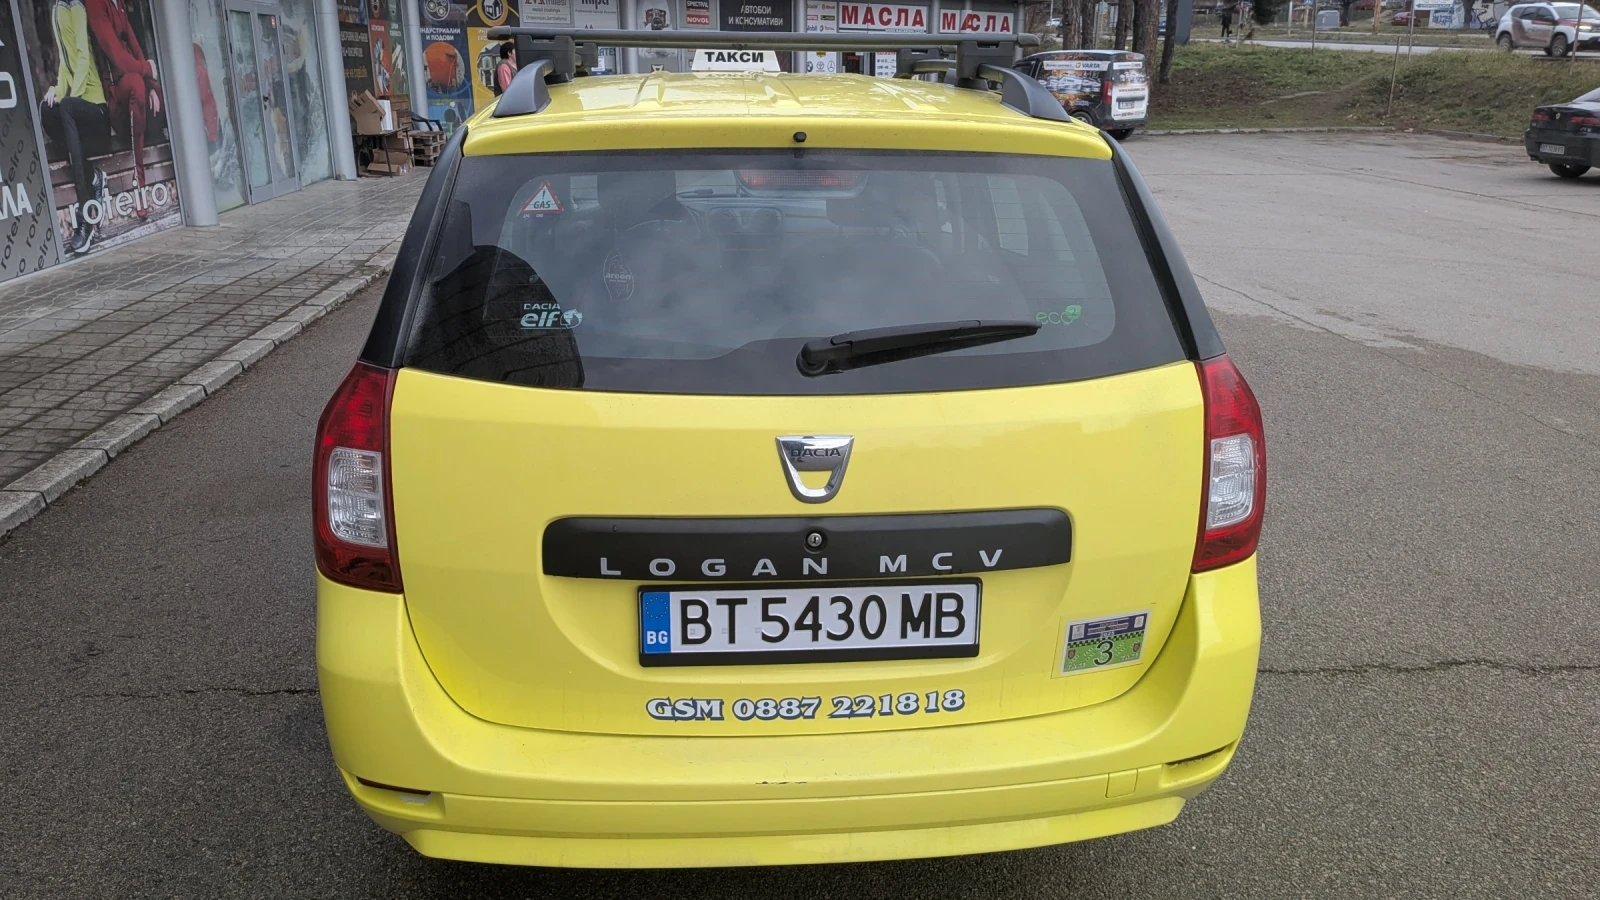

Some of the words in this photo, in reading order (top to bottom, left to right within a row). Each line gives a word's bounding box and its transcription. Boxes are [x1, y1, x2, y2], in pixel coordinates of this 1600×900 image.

[740, 5, 772, 15] АВТОБОИ
[841, 5, 925, 27] МАСЛА
[728, 16, 734, 25] И
[735, 17, 784, 26] КОНСУМАТИВИ
[941, 12, 1010, 33] МАСЛА
[704, 52, 764, 63] ТАКСИ
[68, 180, 168, 229] roteiro
[533, 200, 551, 209] GAS
[520, 311, 561, 327] elf
[790, 447, 841, 457] DACIA
[600, 557, 828, 576] LOGAN
[879, 549, 1003, 573] MCV
[680, 597, 748, 645] BT
[761, 594, 887, 643] 5430
[900, 592, 966, 639] MB
[646, 631, 668, 645] BG
[1094, 640, 1114, 665] 3
[646, 697, 725, 722] GSM
[732, 696, 821, 721] 0887
